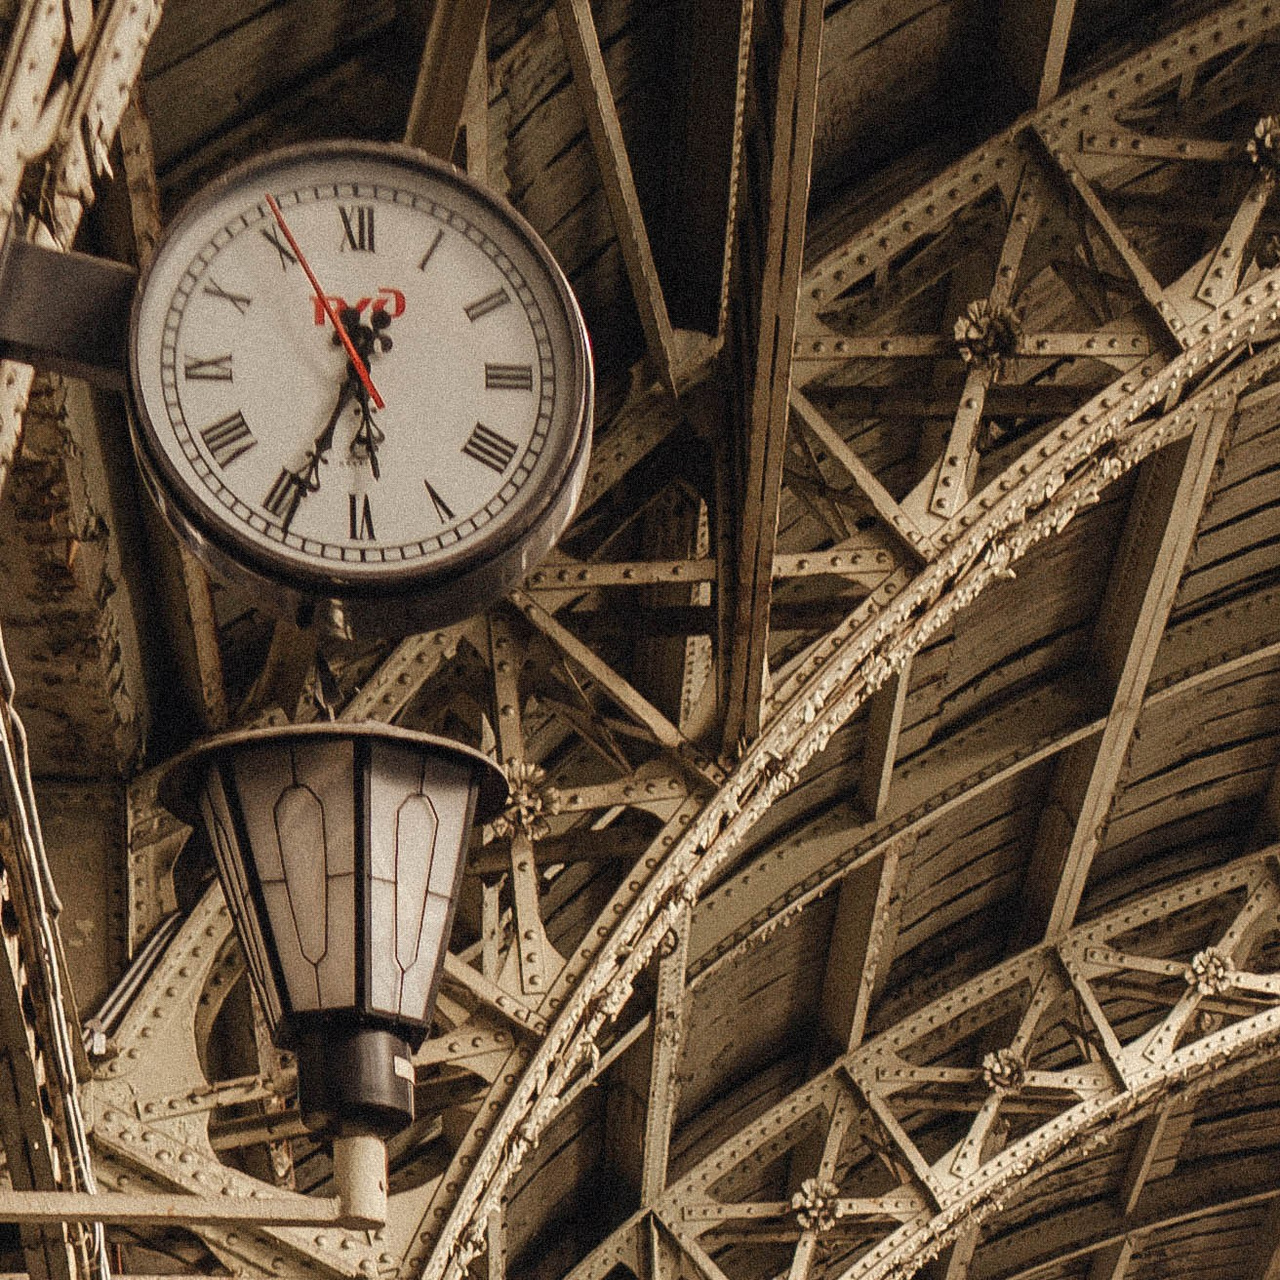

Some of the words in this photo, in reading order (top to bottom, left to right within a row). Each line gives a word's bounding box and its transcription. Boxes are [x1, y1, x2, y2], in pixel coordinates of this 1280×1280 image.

[339, 205, 376, 253] XII
[202, 276, 251, 315] X
[463, 288, 512, 322] II
[184, 353, 234, 383] IX
[484, 363, 533, 392] III
[199, 410, 258, 470] VIII
[347, 493, 377, 542] VI
[423, 479, 456, 525] V
